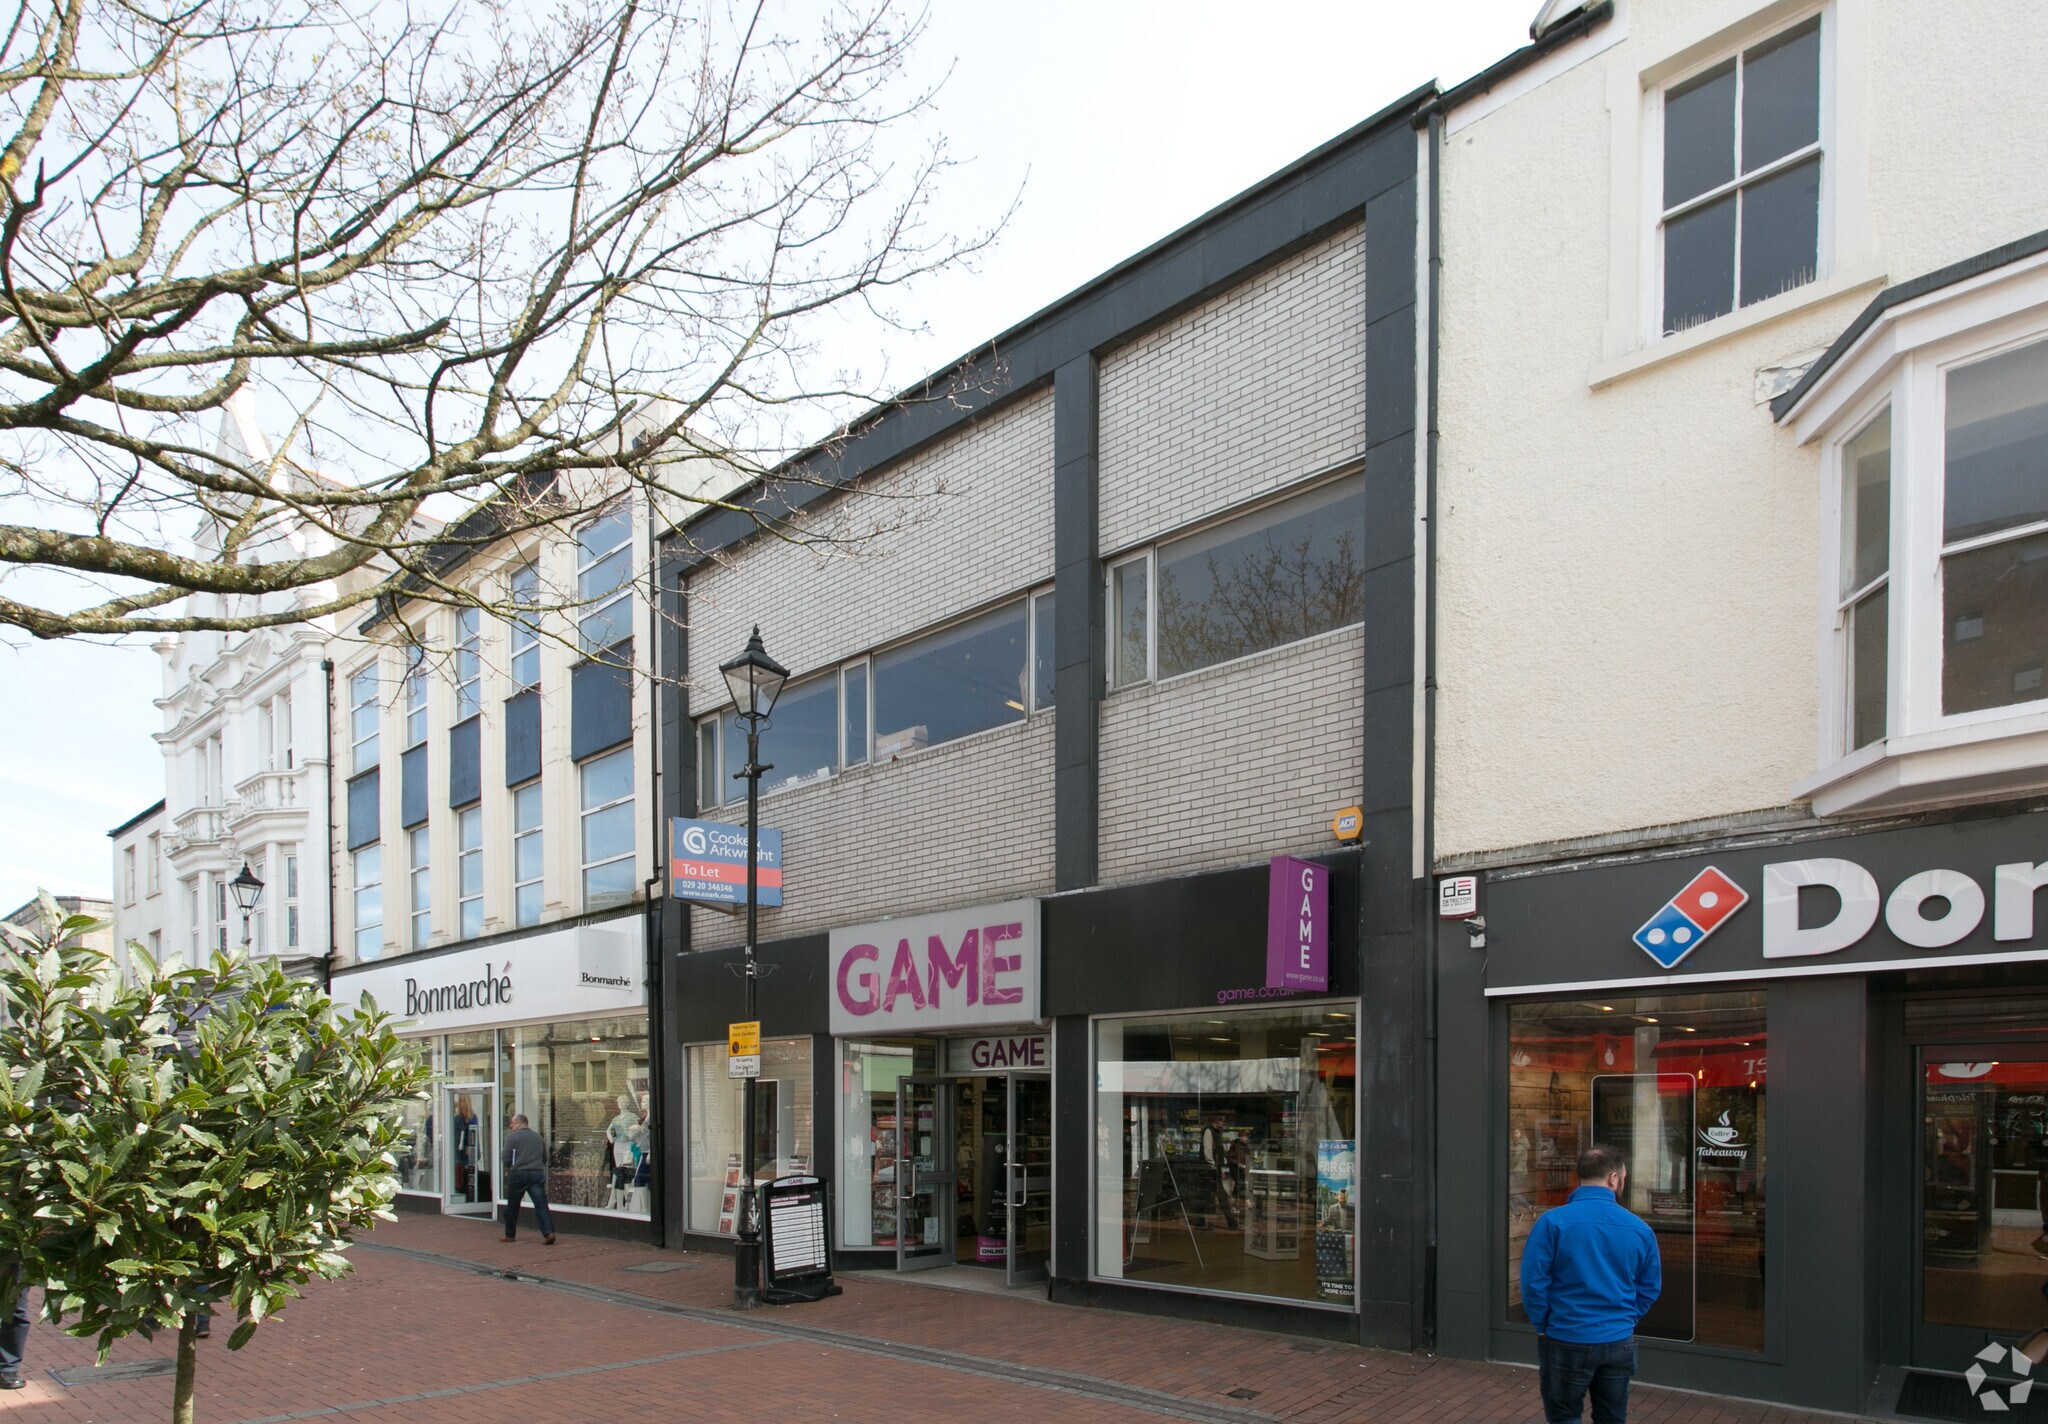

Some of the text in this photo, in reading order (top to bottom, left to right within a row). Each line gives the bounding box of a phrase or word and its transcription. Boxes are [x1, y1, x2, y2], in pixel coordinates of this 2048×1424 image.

[1339, 817, 1356, 828] ADT
[708, 830, 749, 846] Cooke
[682, 864, 720, 878] To Let
[682, 880, 733, 892] 029 20 346346
[682, 890, 735, 900] www.coark.com
[1299, 868, 1314, 969] GAME
[836, 922, 1023, 1017] GAME
[404, 960, 513, 1016] Bonmarché
[581, 972, 632, 988] Bonmarché
[971, 1037, 1045, 1068] GAME
[1697, 1147, 1747, 1160] Takeaway
